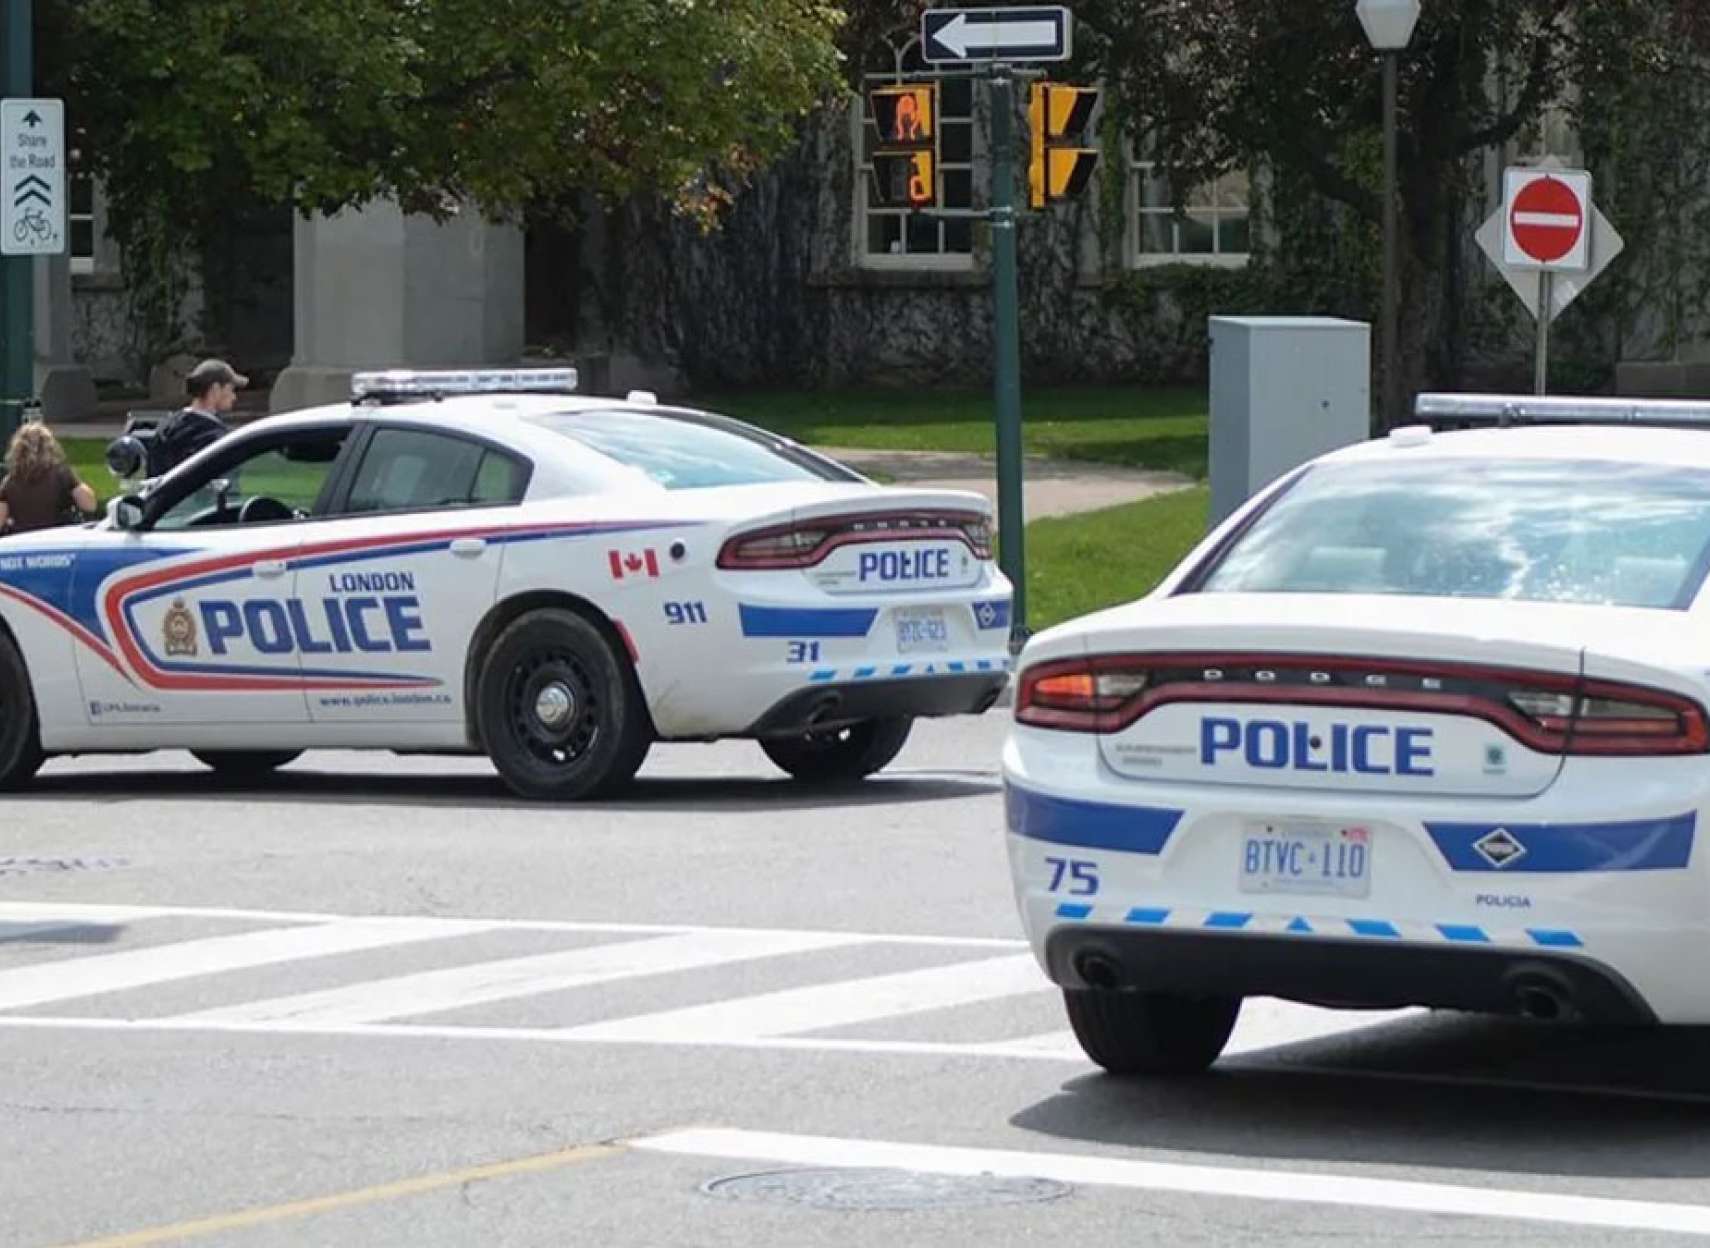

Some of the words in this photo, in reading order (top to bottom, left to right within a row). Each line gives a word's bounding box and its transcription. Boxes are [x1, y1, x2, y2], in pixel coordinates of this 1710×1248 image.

[17, 133, 48, 147] Share
[10, 155, 27, 168] the
[28, 154, 56, 168] Road
[859, 549, 949, 582] POLICE
[329, 572, 415, 592] LONDON
[664, 600, 707, 625] 911
[199, 596, 433, 655] POLICE
[786, 641, 820, 664] 31
[1203, 669, 1442, 690] DODGE
[1201, 717, 1435, 776] POLICE
[1045, 857, 1100, 896] 75
